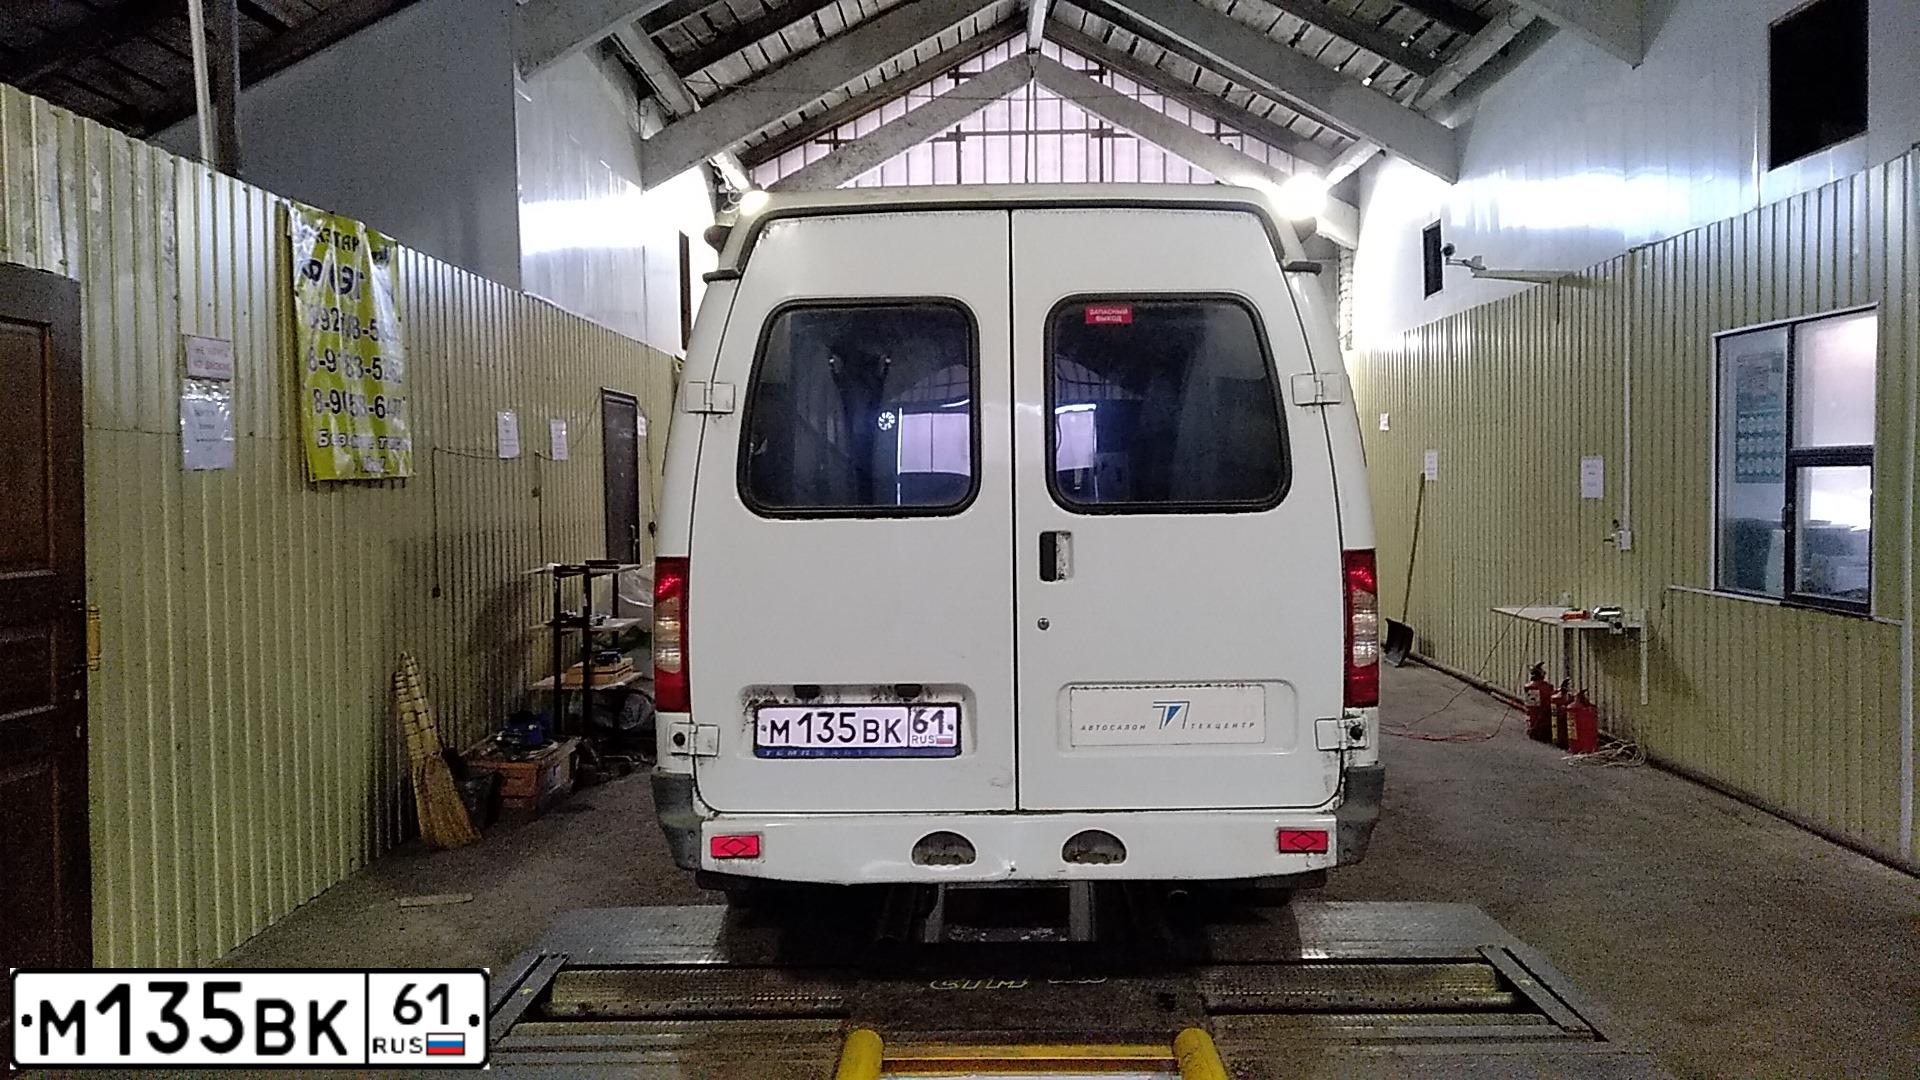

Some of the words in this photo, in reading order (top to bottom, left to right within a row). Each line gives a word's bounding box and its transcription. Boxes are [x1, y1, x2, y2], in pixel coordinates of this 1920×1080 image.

[769, 711, 901, 743] М135ВК
[912, 708, 944, 734] 61
[911, 735, 935, 745] RUS
